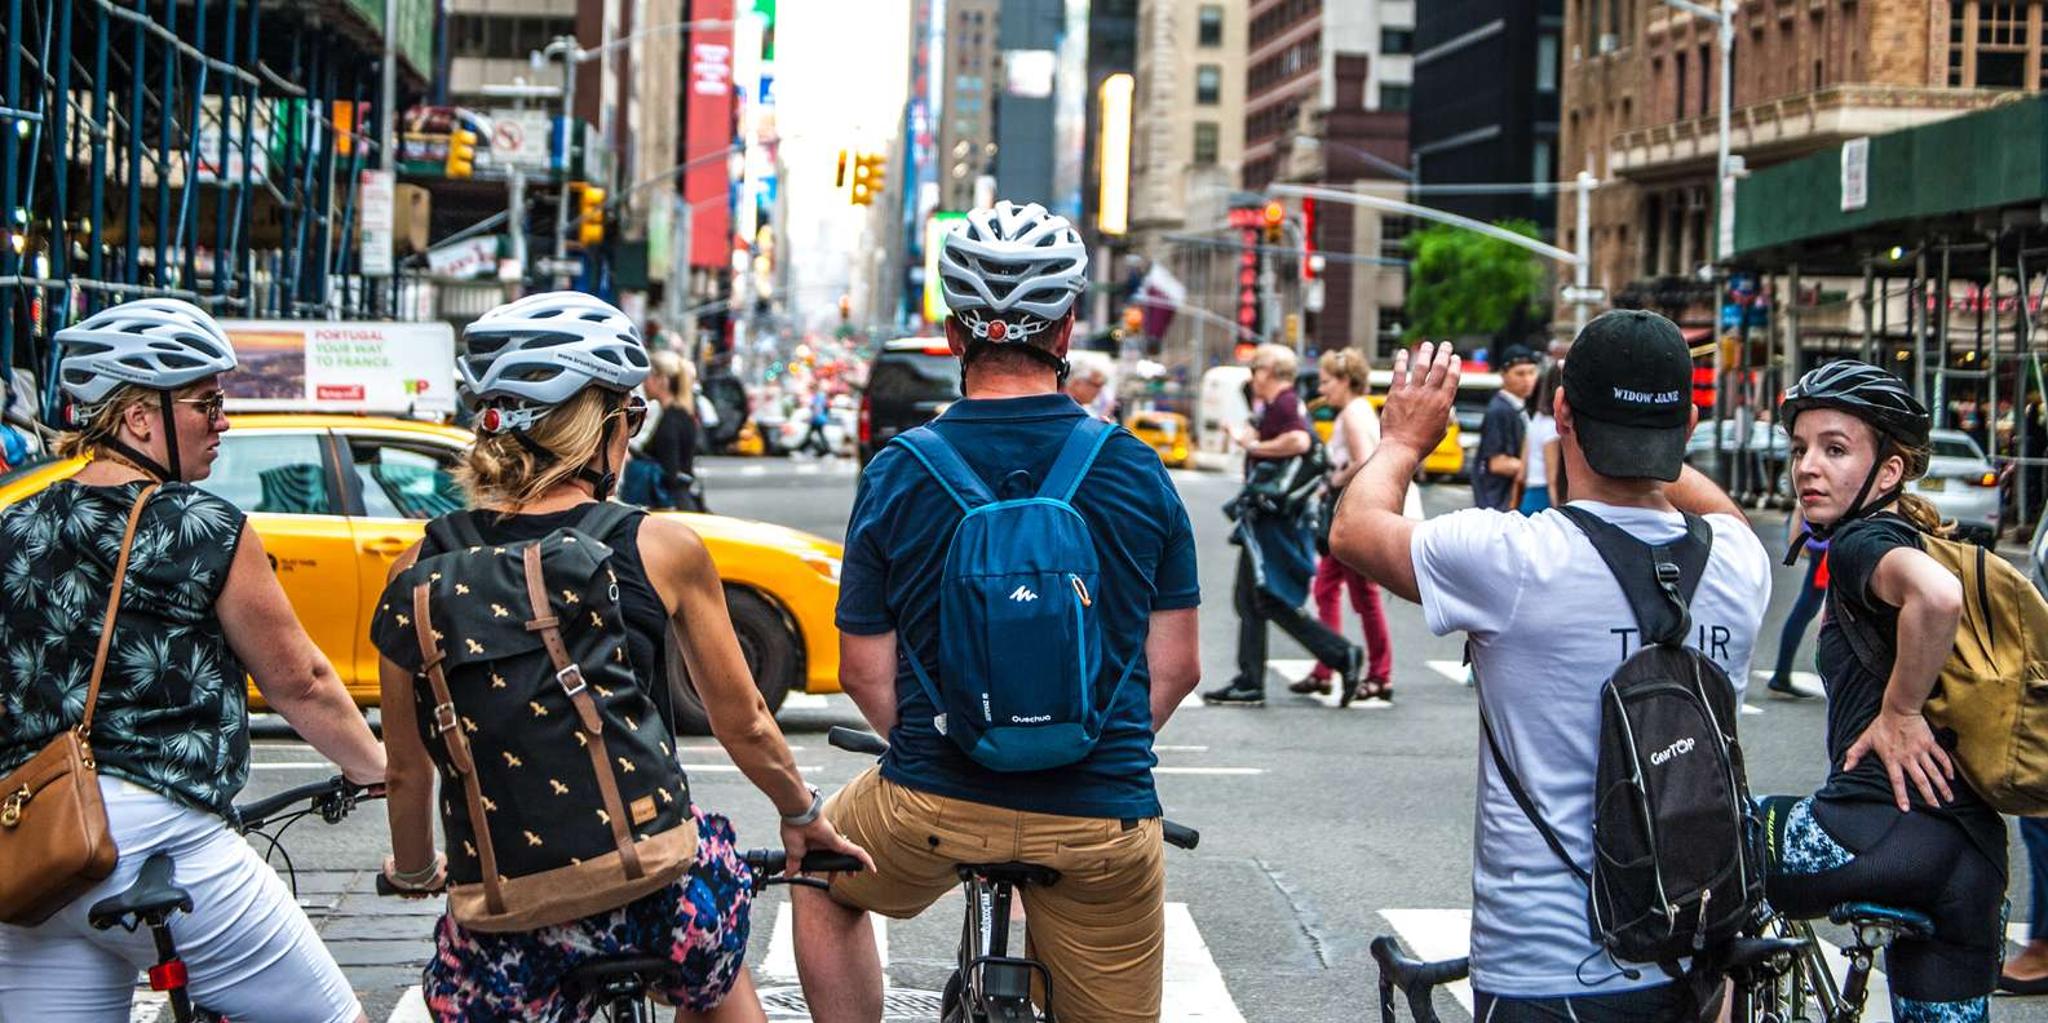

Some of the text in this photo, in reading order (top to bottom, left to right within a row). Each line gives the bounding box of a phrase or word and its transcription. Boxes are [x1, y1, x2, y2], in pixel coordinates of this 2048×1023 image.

[315, 330, 383, 340] PORTUGAL
[316, 344, 382, 353] YOUR WAY
[316, 356, 333, 366] TO
[1613, 386, 1679, 403] WIDOW JANE
[1011, 714, 1051, 723] Quechua
